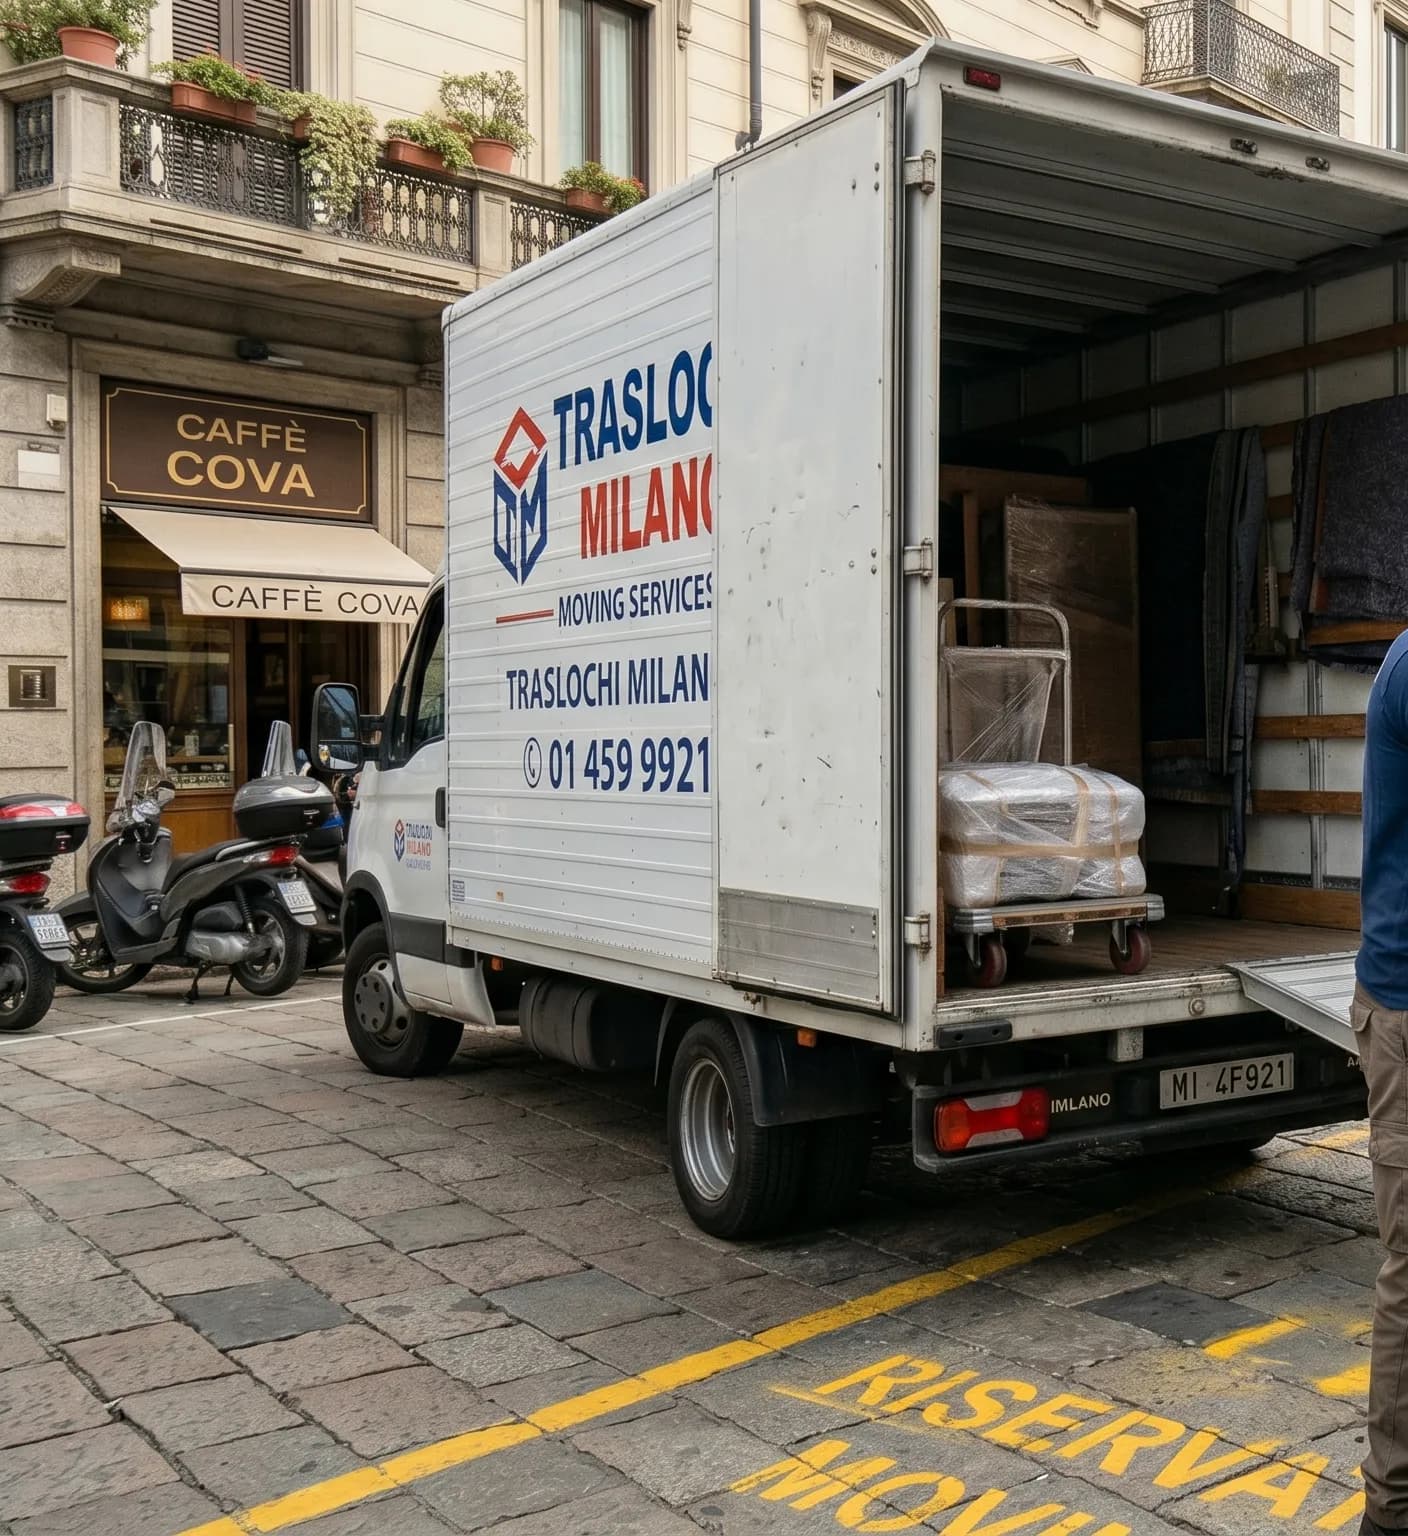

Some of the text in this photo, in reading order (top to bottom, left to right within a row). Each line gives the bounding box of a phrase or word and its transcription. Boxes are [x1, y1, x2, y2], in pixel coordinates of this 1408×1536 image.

[177, 413, 306, 453] CAFFÈ
[167, 450, 316, 498] COVA
[212, 585, 418, 616] CAFFÈ COVA
[559, 572, 712, 627] MOVING SERVICES
[506, 653, 709, 710] TRASLOCHI MILAN
[550, 737, 709, 793] 01 459 9921
[1051, 1092, 1110, 1114] IMLANO
[1173, 1060, 1285, 1102] MI 4F921
